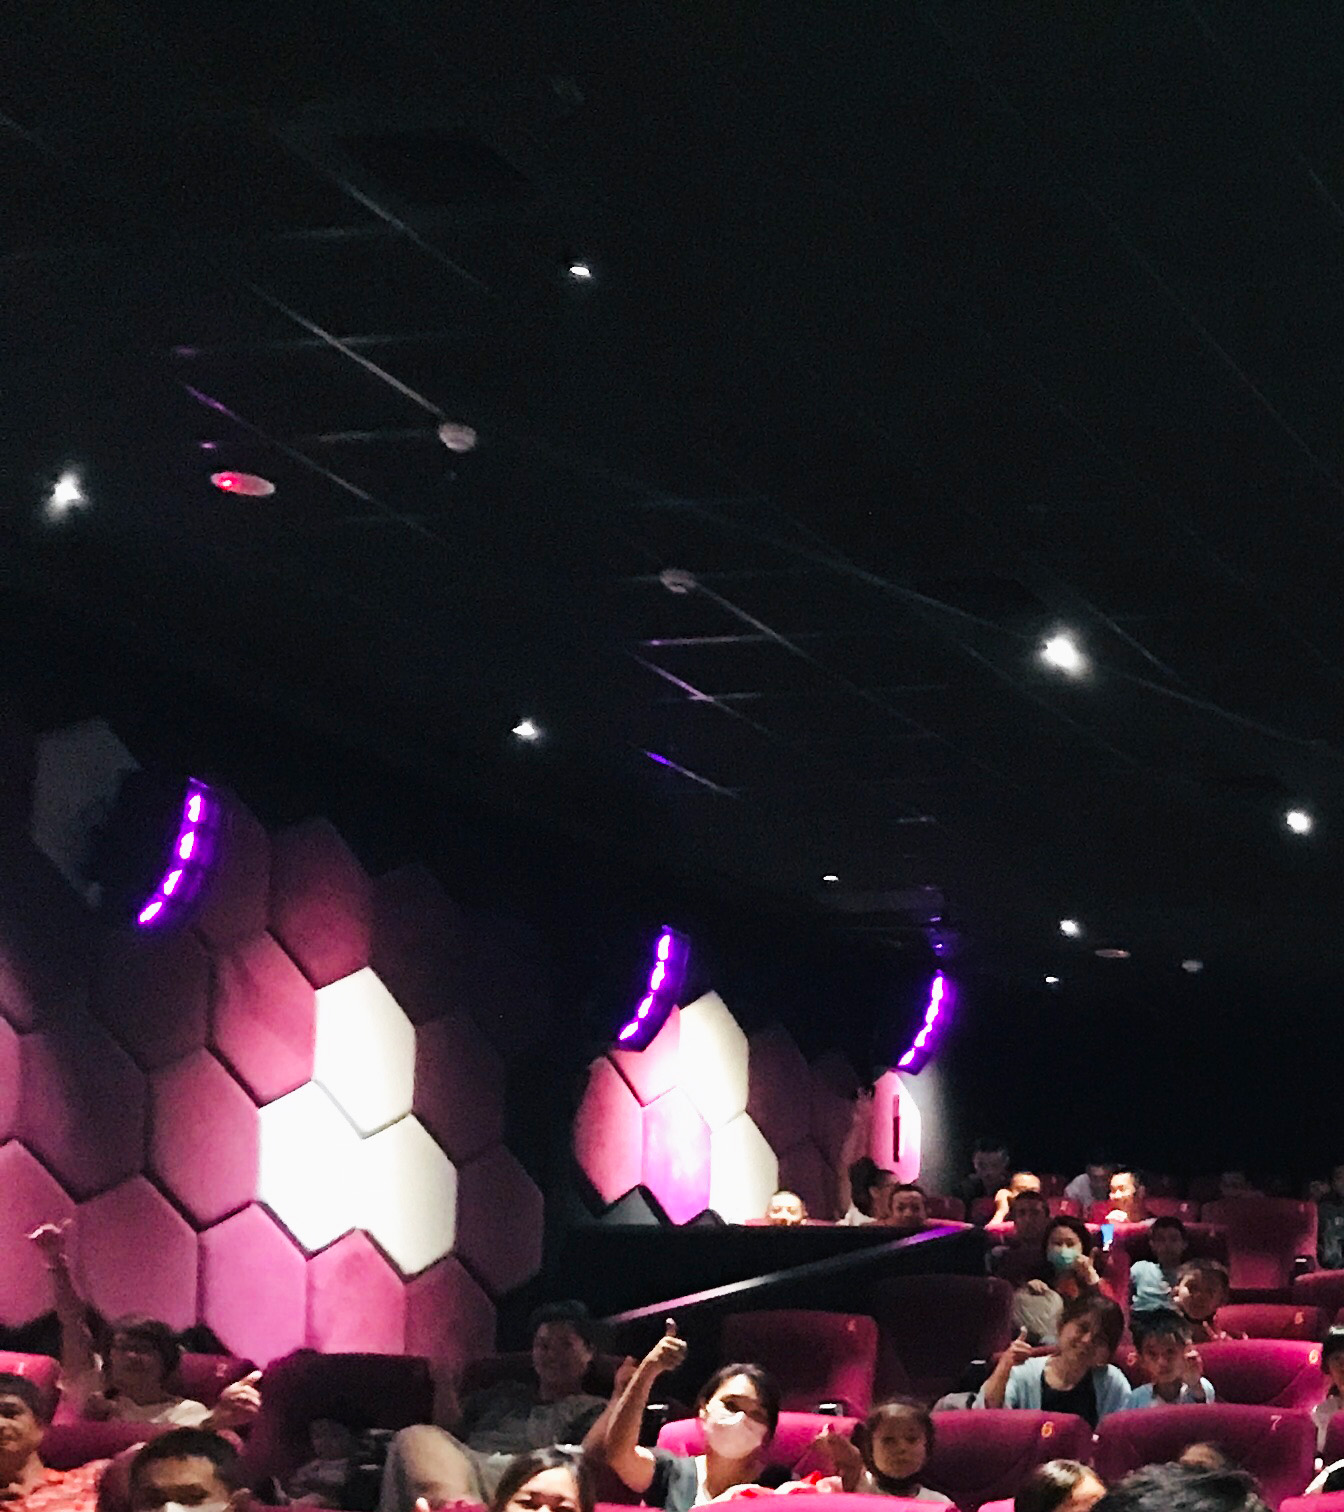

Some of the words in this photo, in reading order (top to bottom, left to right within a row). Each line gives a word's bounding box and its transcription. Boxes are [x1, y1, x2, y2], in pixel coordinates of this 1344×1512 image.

[1309, 1350, 1319, 1363] 6
[1041, 1422, 1054, 1437] 6
[1269, 1416, 1282, 1430] 7
